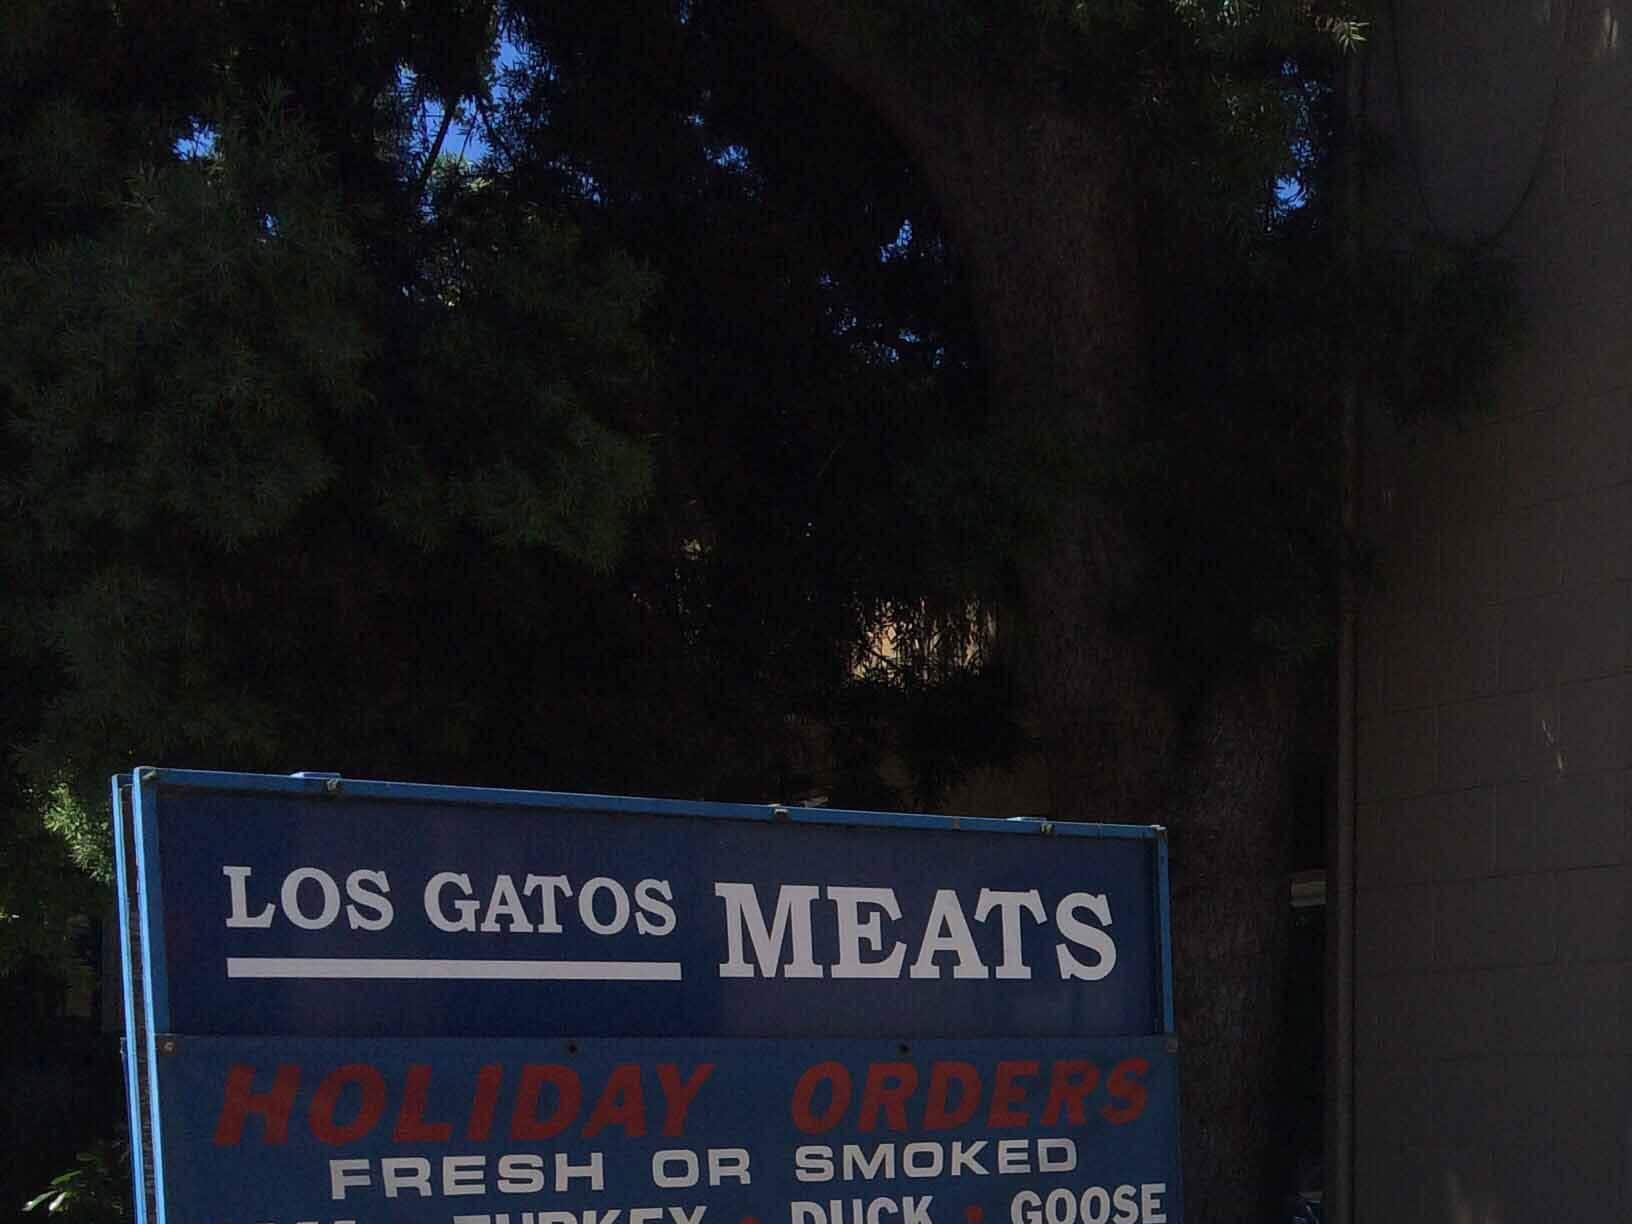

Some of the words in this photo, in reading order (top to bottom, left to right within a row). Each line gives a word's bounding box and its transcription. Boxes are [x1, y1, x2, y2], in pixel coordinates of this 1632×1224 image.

[223, 866, 394, 930] LOS
[424, 872, 677, 935] GATOS
[715, 882, 1117, 981] MEATS
[215, 1062, 715, 1145] HOLIDAY
[791, 1057, 1150, 1133] ORDERS
[330, 1152, 604, 1200] FRESH
[652, 1148, 751, 1188] OR
[795, 1137, 1078, 1182] SMOKED
